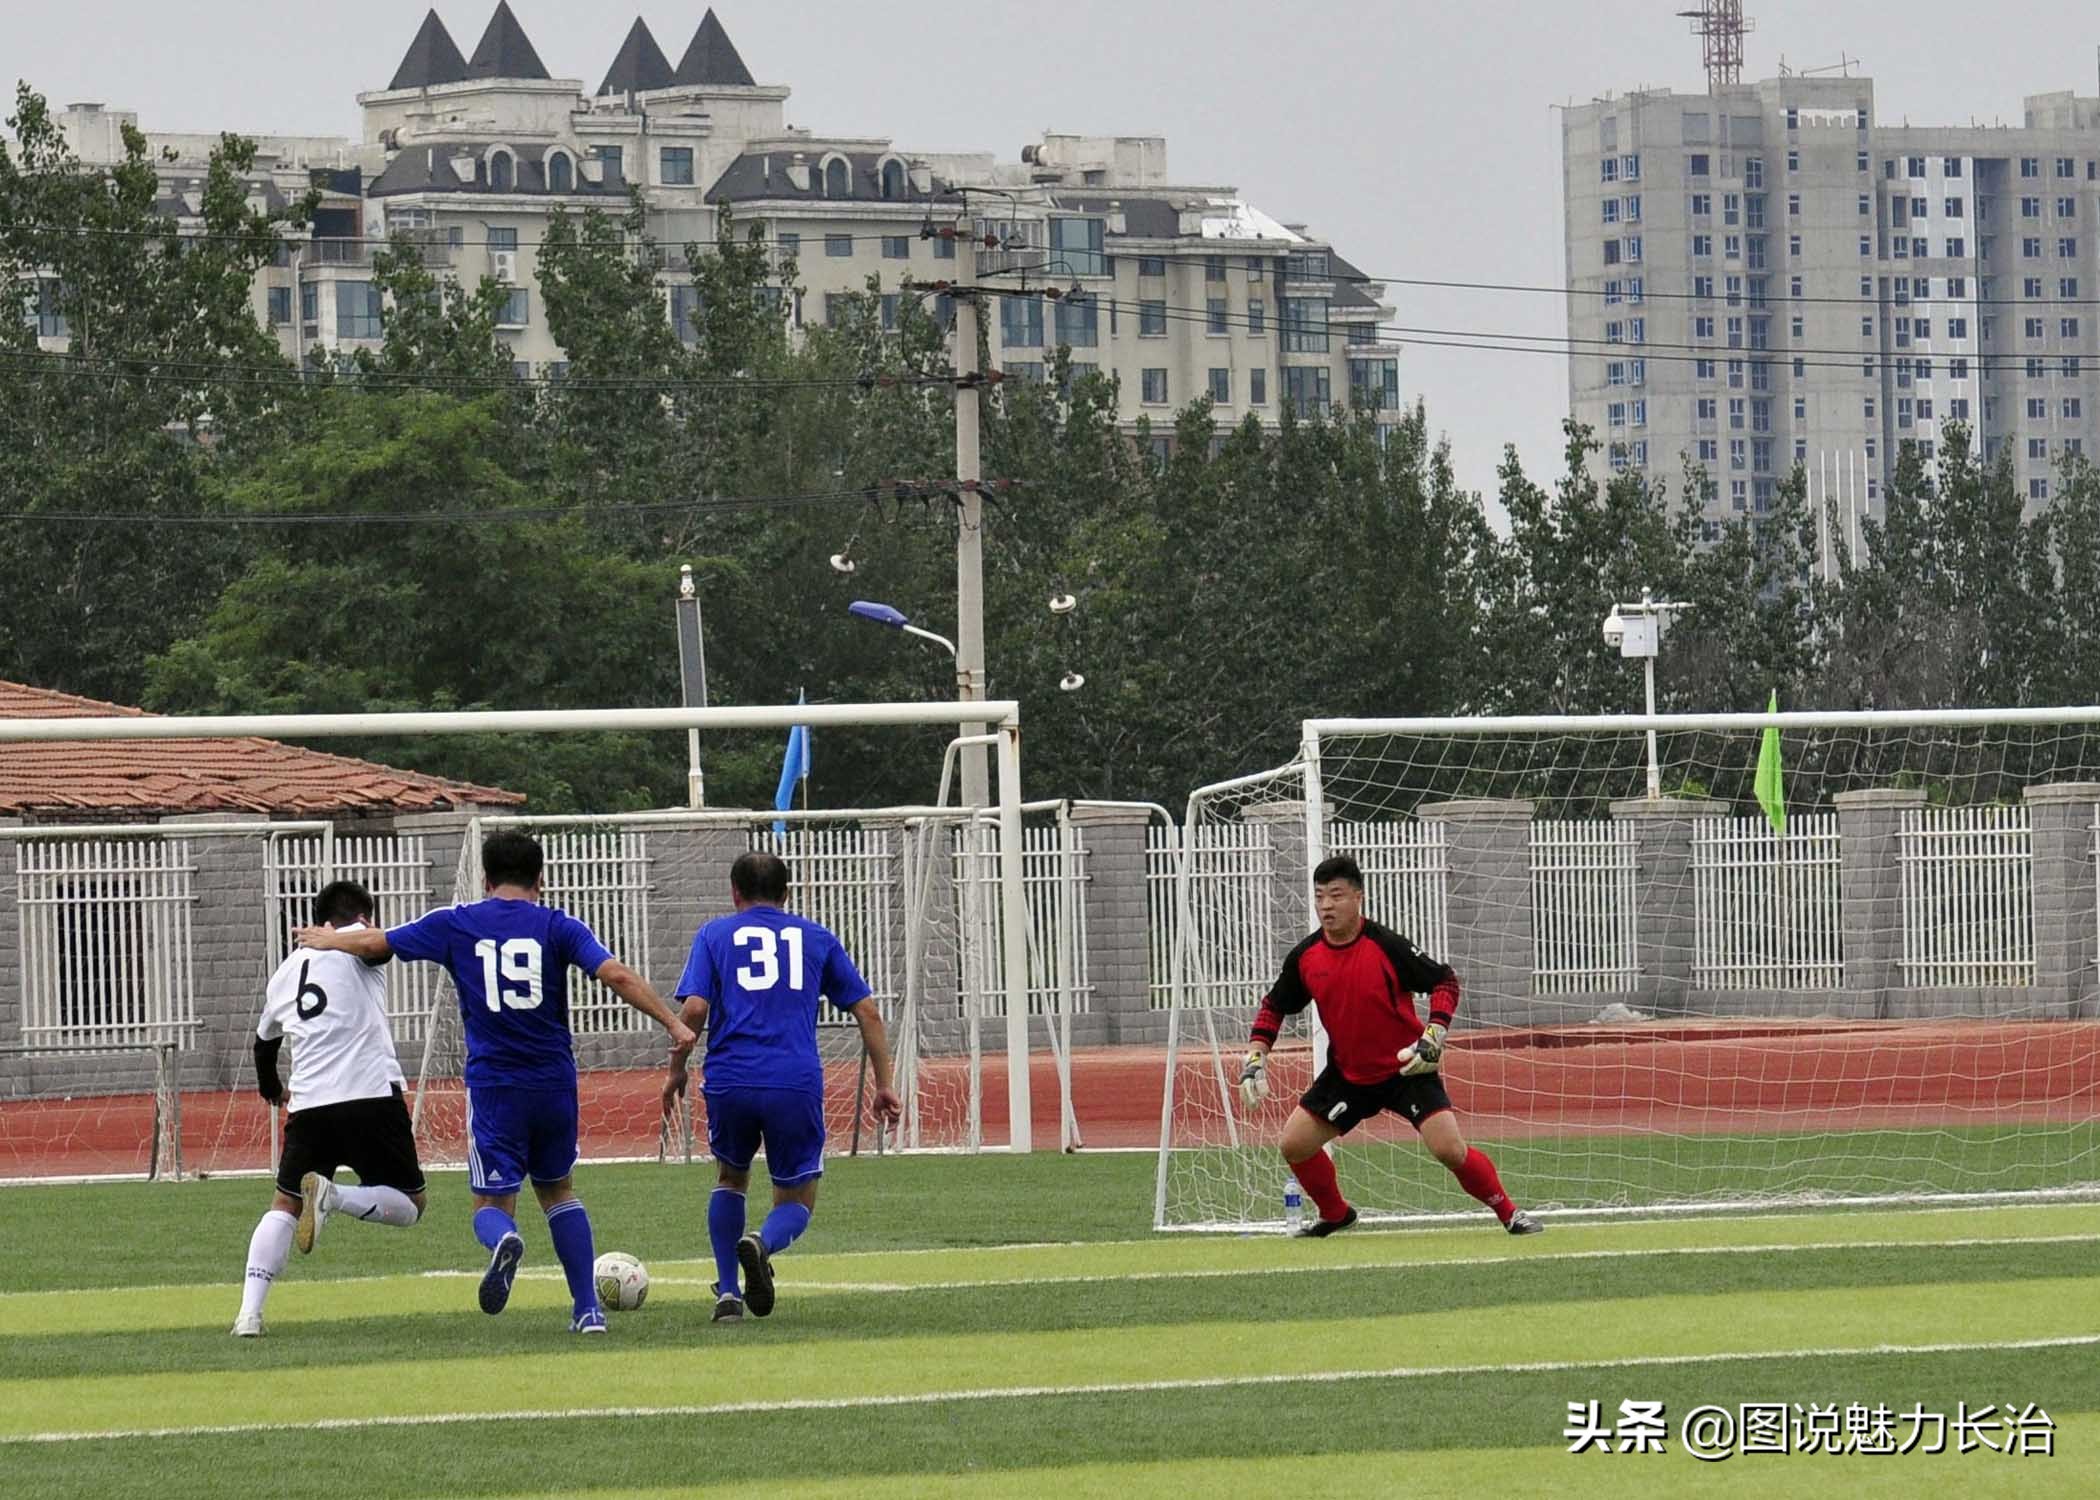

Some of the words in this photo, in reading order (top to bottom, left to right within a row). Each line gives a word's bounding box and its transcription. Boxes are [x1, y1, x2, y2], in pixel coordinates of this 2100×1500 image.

[297, 959, 327, 1020] 6
[475, 938, 543, 1013] 19
[733, 926, 803, 991] 31
